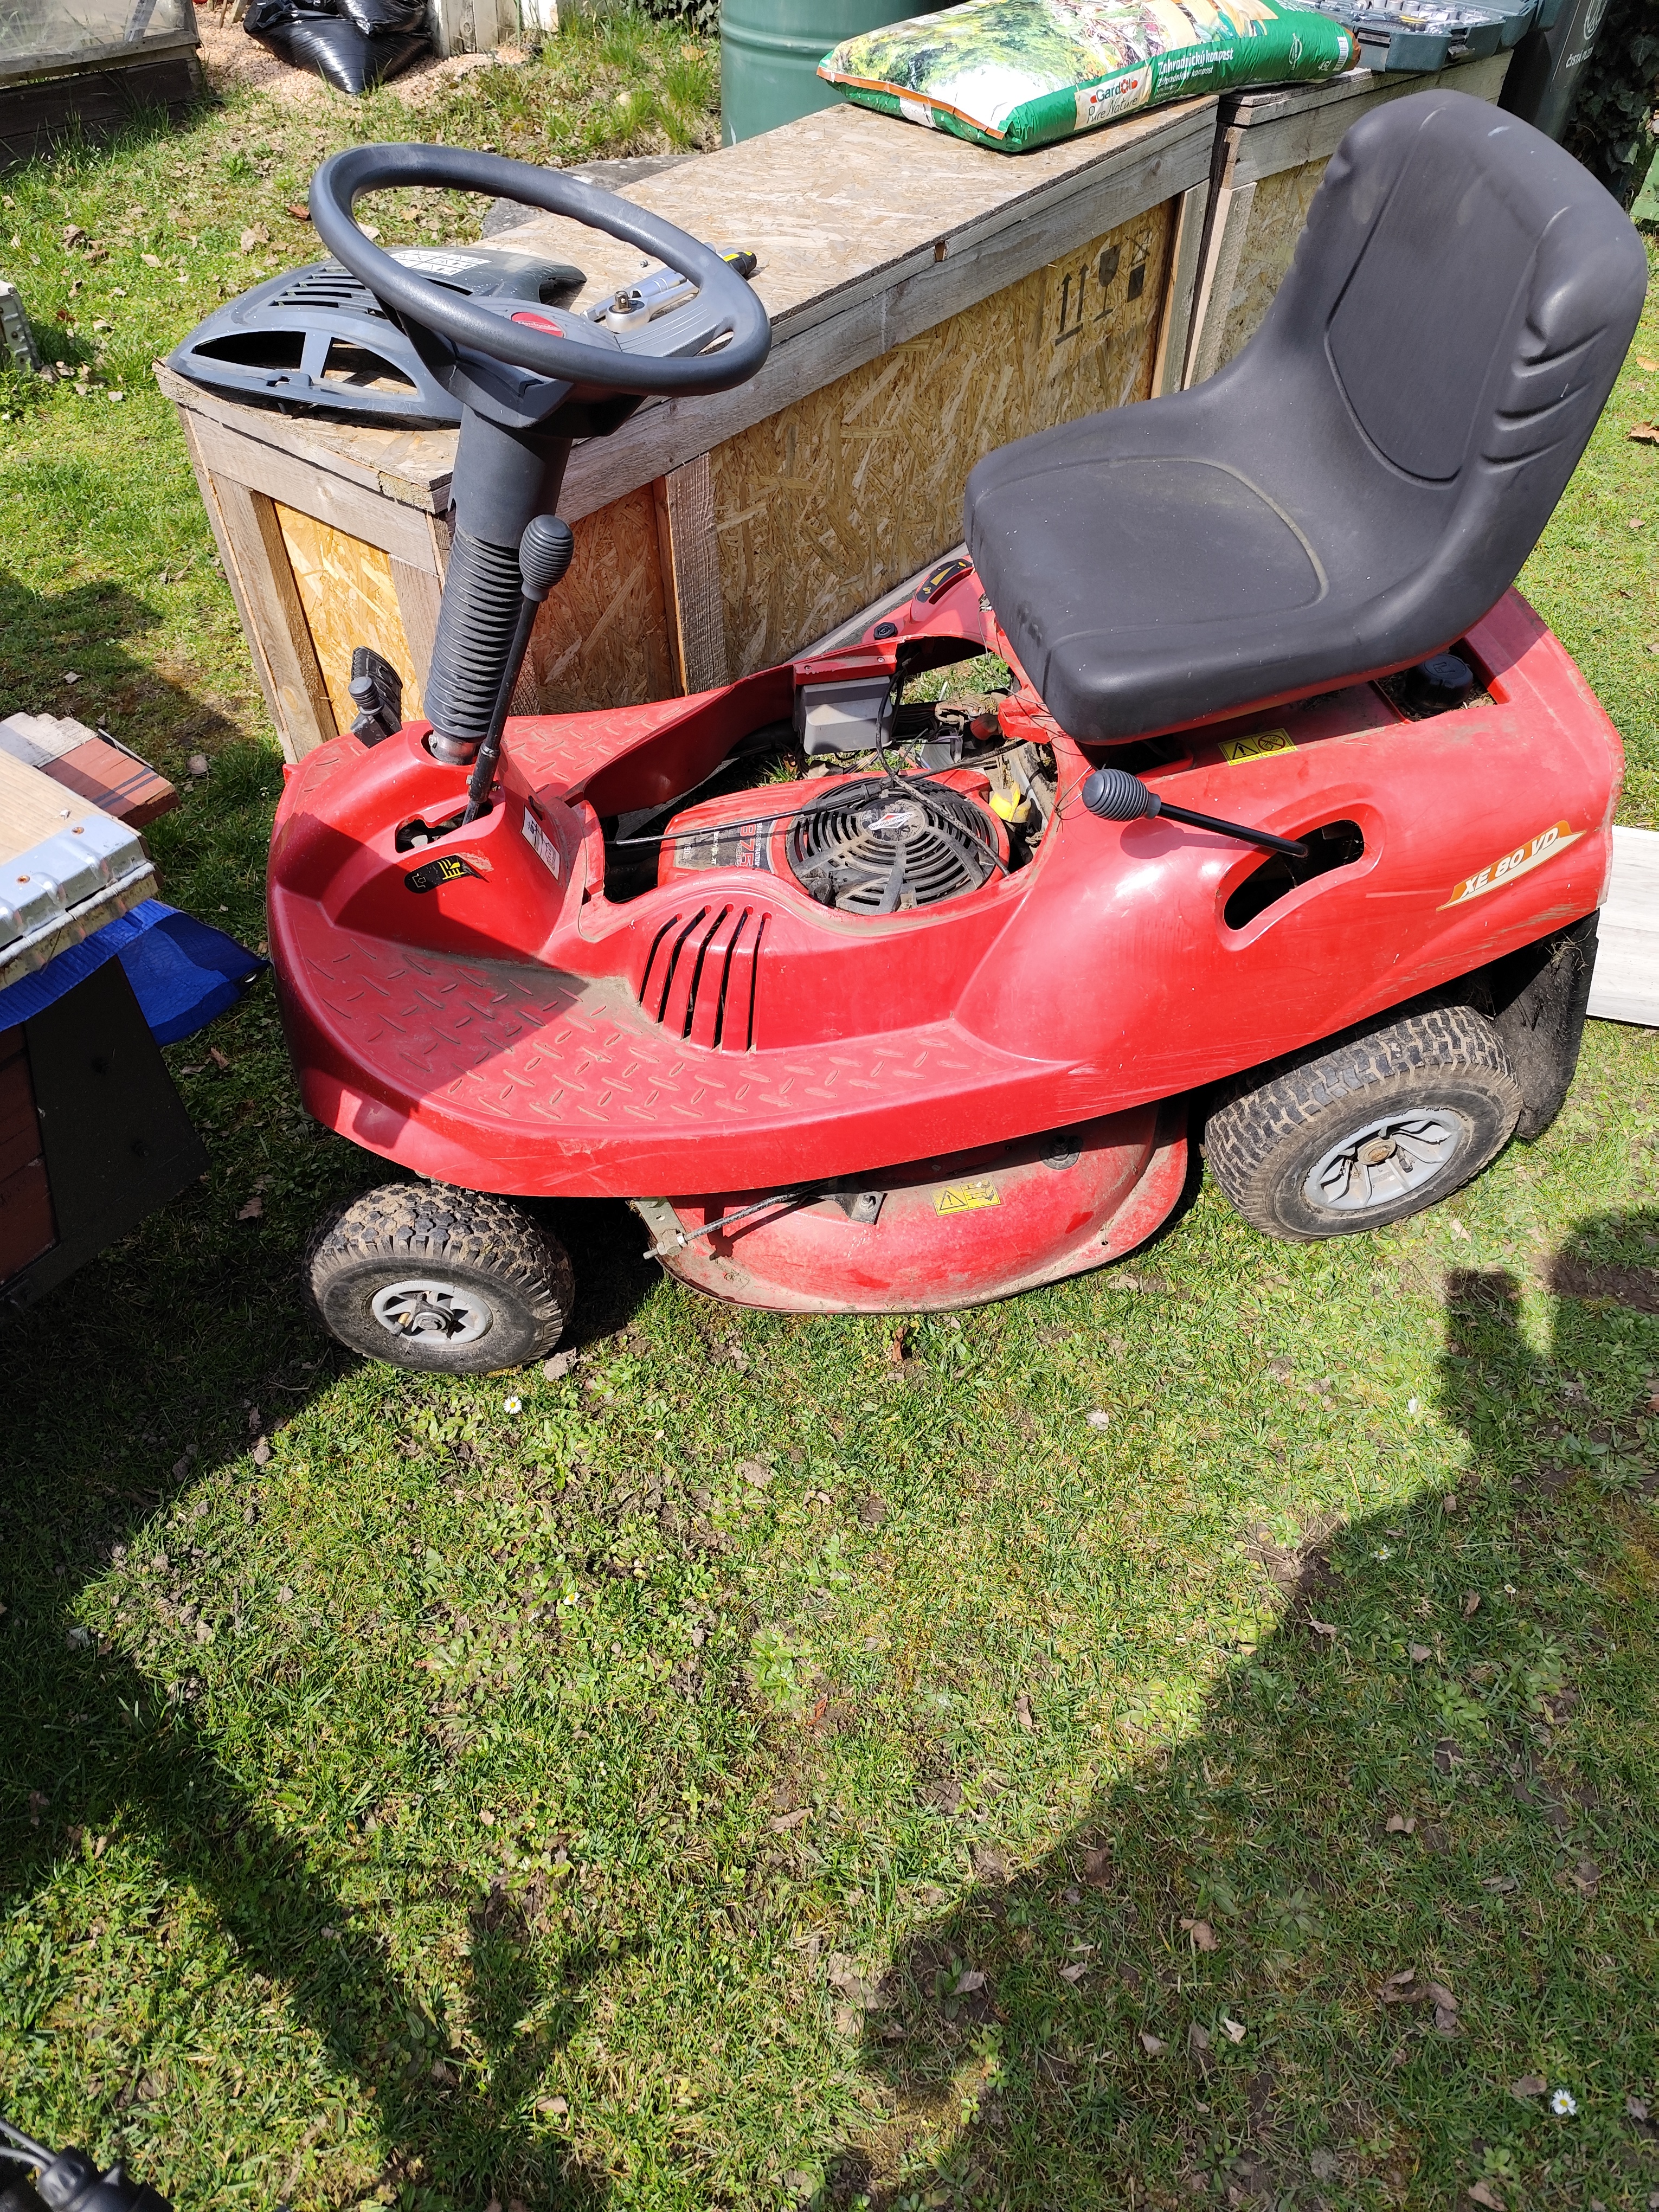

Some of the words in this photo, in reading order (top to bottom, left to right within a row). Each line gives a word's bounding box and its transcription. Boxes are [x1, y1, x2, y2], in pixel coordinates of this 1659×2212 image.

[1158, 50, 1206, 76] Zahradnický
[1206, 47, 1234, 64] kompost
[1086, 105, 1106, 124] Pure
[1107, 97, 1138, 117] Nature
[1460, 867, 1491, 898] XE
[1495, 848, 1525, 878] 80
[1532, 827, 1559, 856] VD
